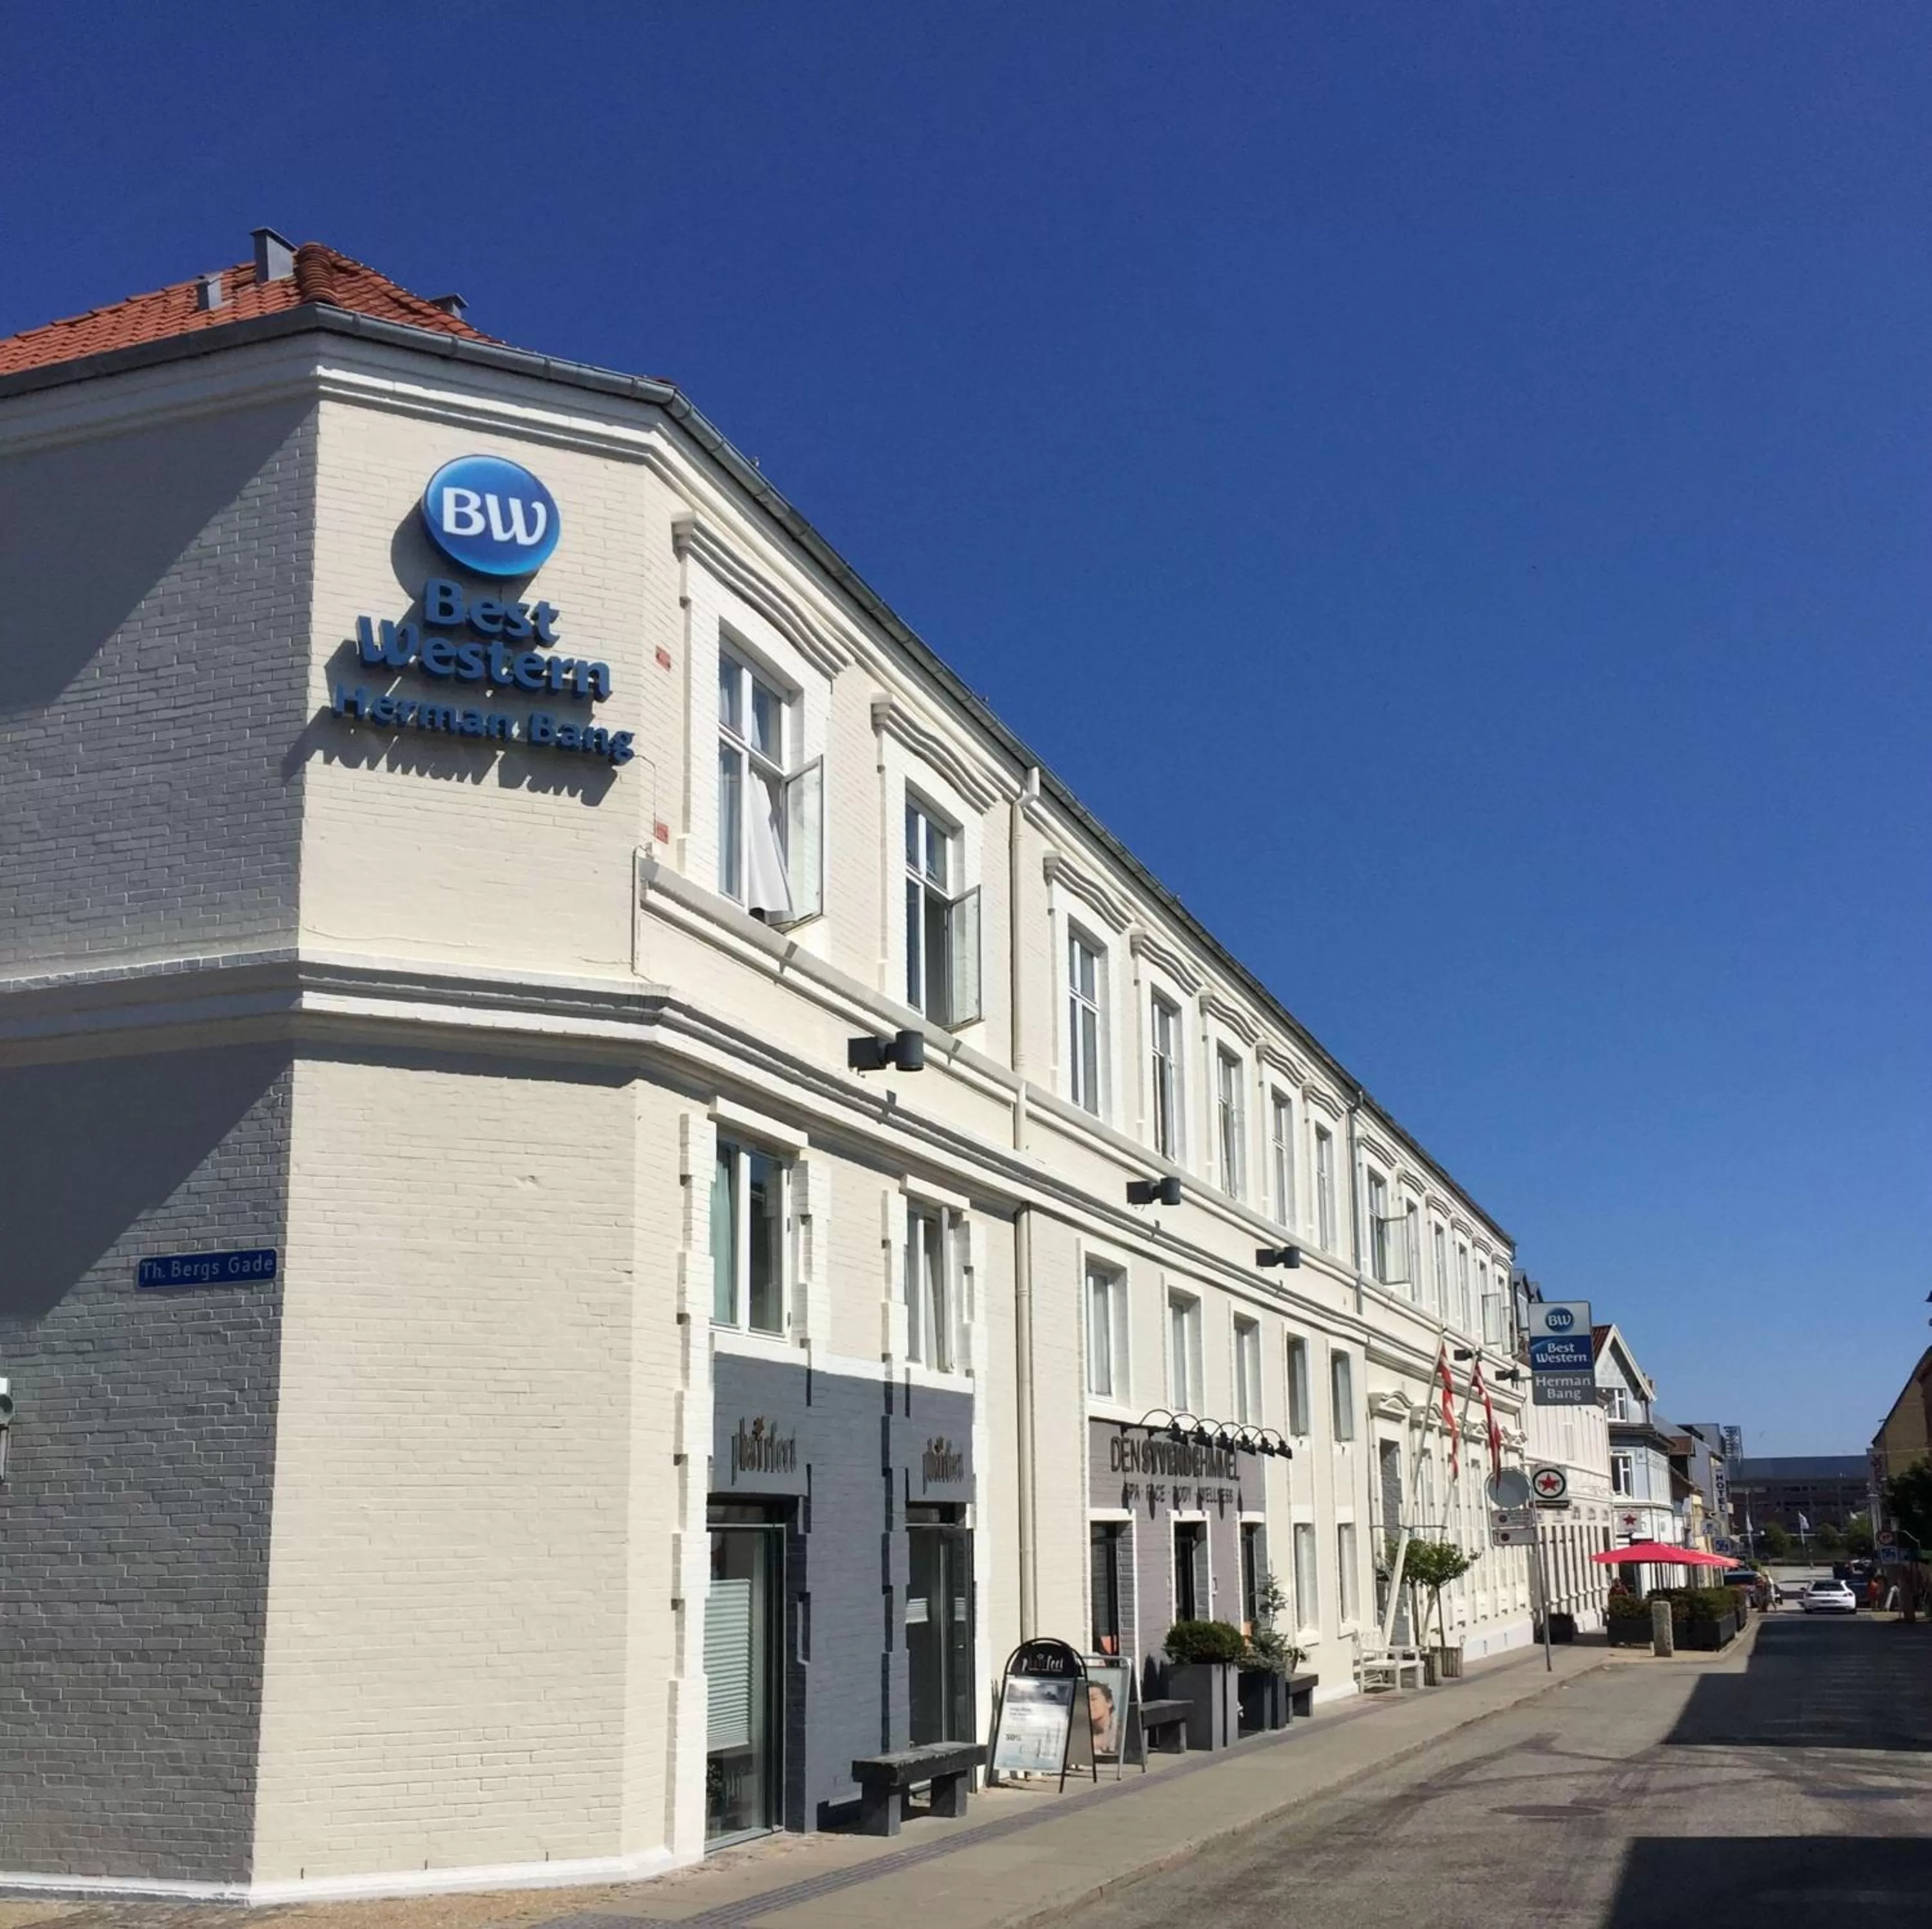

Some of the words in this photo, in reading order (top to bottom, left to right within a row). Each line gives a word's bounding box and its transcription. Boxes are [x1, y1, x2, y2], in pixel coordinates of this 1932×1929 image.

[442, 486, 547, 545] BW
[422, 578, 560, 648] Best
[355, 615, 614, 702] Western
[331, 683, 515, 742] Herman
[528, 710, 636, 766] Bang
[141, 1261, 166, 1279] Th.
[171, 1260, 220, 1281] Bergs
[227, 1254, 274, 1274] Gade
[1548, 1314, 1572, 1327] BW
[1535, 1353, 1588, 1364] Western
[1547, 1342, 1575, 1353] Best
[1535, 1375, 1591, 1387] Herman
[1547, 1388, 1582, 1401] Bang
[1716, 1474, 1726, 1512] HOTEL
